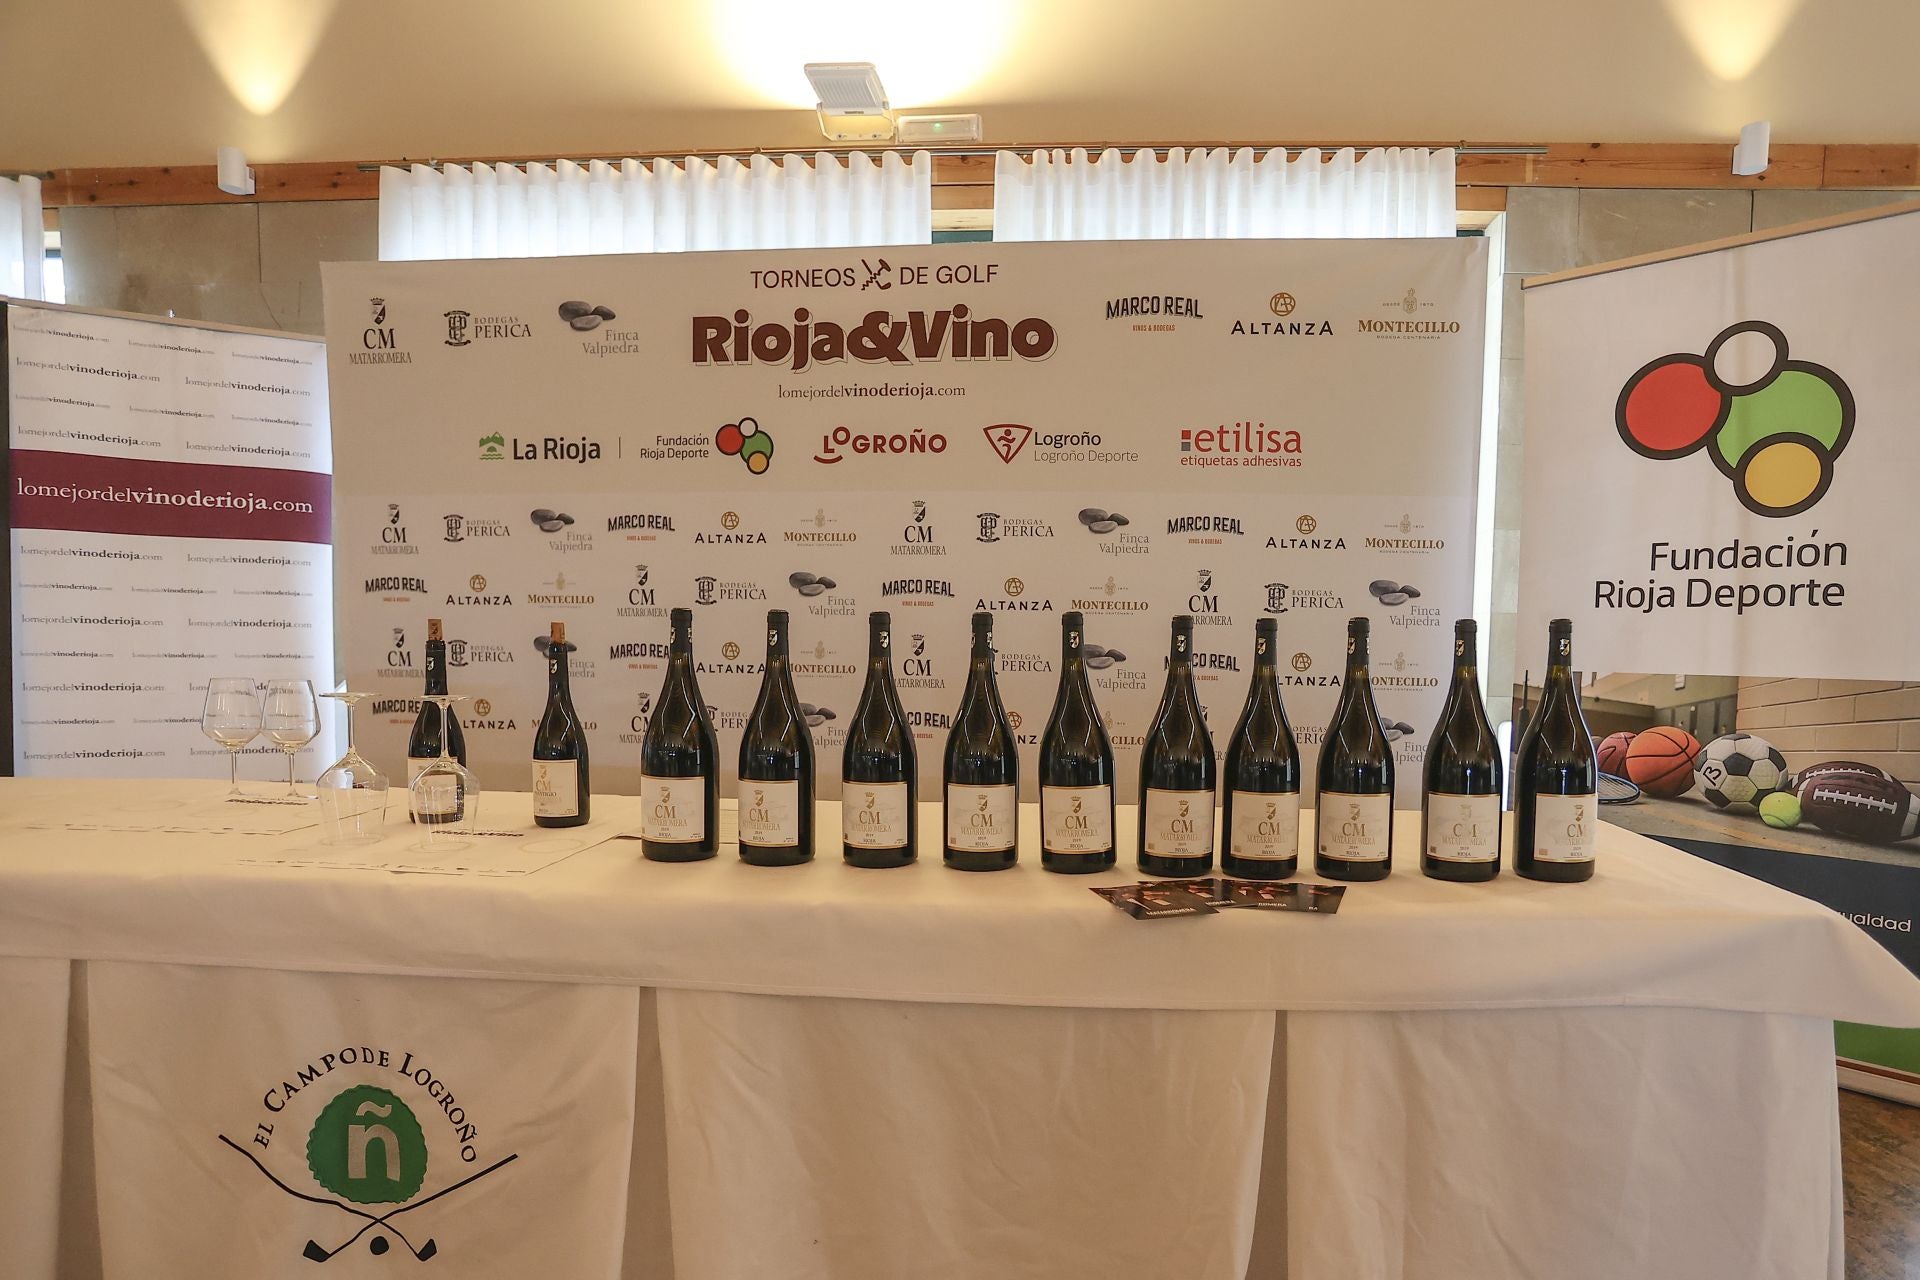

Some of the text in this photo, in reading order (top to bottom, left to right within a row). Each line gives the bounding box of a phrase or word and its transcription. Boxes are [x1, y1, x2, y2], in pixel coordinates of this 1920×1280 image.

[751, 264, 999, 289] TORNEOS DE GOLF
[1106, 296, 1203, 320] MARCO REAL
[474, 316, 519, 324] BODEGAS
[1358, 319, 1460, 333] MONTECILLO
[474, 325, 532, 339] PERICA
[1231, 320, 1333, 336] ALTANZA
[363, 328, 396, 350] CM
[605, 330, 640, 341] Finca
[692, 303, 1059, 374] Rioja&Vino
[582, 343, 640, 357] Valpiedra
[349, 352, 412, 365] MATARROMERA
[779, 383, 965, 401] lomejordelvinoderioja.com
[656, 434, 709, 447] Fundación
[823, 426, 947, 454] LOGROÑO
[1034, 431, 1101, 449] Logroño
[1195, 422, 1302, 454] etilisa
[513, 436, 601, 463] La Rioja
[640, 448, 709, 461] Rioja Deporte
[1034, 448, 1138, 463] Logroño Deporte
[1181, 454, 1302, 468] etiquetas adhesivas
[17, 478, 313, 514] lomejordelvinoderioja.com
[608, 514, 675, 532] MARCO REAL
[1167, 516, 1244, 535] MARCO REAL
[382, 527, 407, 543] CM
[467, 525, 510, 537] PERICA
[567, 532, 592, 541] Finca
[695, 532, 766, 543] ALTANZA
[784, 532, 856, 542] MONTECILLO
[905, 526, 932, 543] CM
[1004, 526, 1054, 537] PERICA
[1120, 533, 1149, 543] Finca
[1266, 537, 1346, 550] ALTANZA
[1365, 537, 1444, 549] MONTECILLO
[549, 542, 593, 553] Valpiedra
[890, 546, 946, 555] MATARROMERA
[1100, 543, 1149, 556] Valpiedra
[1650, 530, 1847, 571] Fundación
[365, 577, 427, 593] MARCO REAL
[882, 579, 955, 597] MARCO REAL
[446, 595, 512, 605] ALTANZA
[528, 594, 594, 604] MONTECILLO
[629, 589, 655, 605] CM
[720, 589, 766, 599] PERICA
[1595, 579, 1845, 614] Rioja Deporte
[828, 596, 855, 606] Finca
[976, 599, 1053, 611] ALTANZA
[1071, 600, 1148, 610] MONTECILLO
[1189, 595, 1218, 612] CM
[1292, 597, 1344, 608] PERICA
[617, 607, 668, 617] MATARROMERA
[809, 606, 855, 618] Valpiedra
[1411, 606, 1440, 615] Finca
[1390, 616, 1440, 629] Valpiedra
[471, 652, 514, 662] PERICA
[610, 643, 670, 660] MARCO REA
[388, 651, 412, 667] CM
[570, 659, 595, 668] Finca
[1210, 654, 1240, 672] REAL
[696, 662, 765, 673] ALTANZA
[903, 659, 931, 676] CM
[1002, 661, 1052, 672] PERICA
[1117, 669, 1146, 679] Finca
[1096, 679, 1146, 692] Valpiedra
[1278, 675, 1340, 687] LTANZA
[1372, 676, 1438, 687] ONTECILLO
[373, 700, 406, 714] MARCO
[463, 720, 516, 730] LTANZA
[655, 805, 676, 818] CM
[750, 809, 768, 822] CM
[859, 811, 881, 824] CM
[971, 814, 993, 827] CM
[1065, 816, 1088, 829] CM
[1171, 820, 1193, 833] CM
[1259, 822, 1280, 835] CM
[1342, 823, 1365, 836] CM
[254, 1123, 274, 1149] EL
[399, 1053, 477, 1162] LOGROÑO
[348, 1101, 400, 1181] ñ
